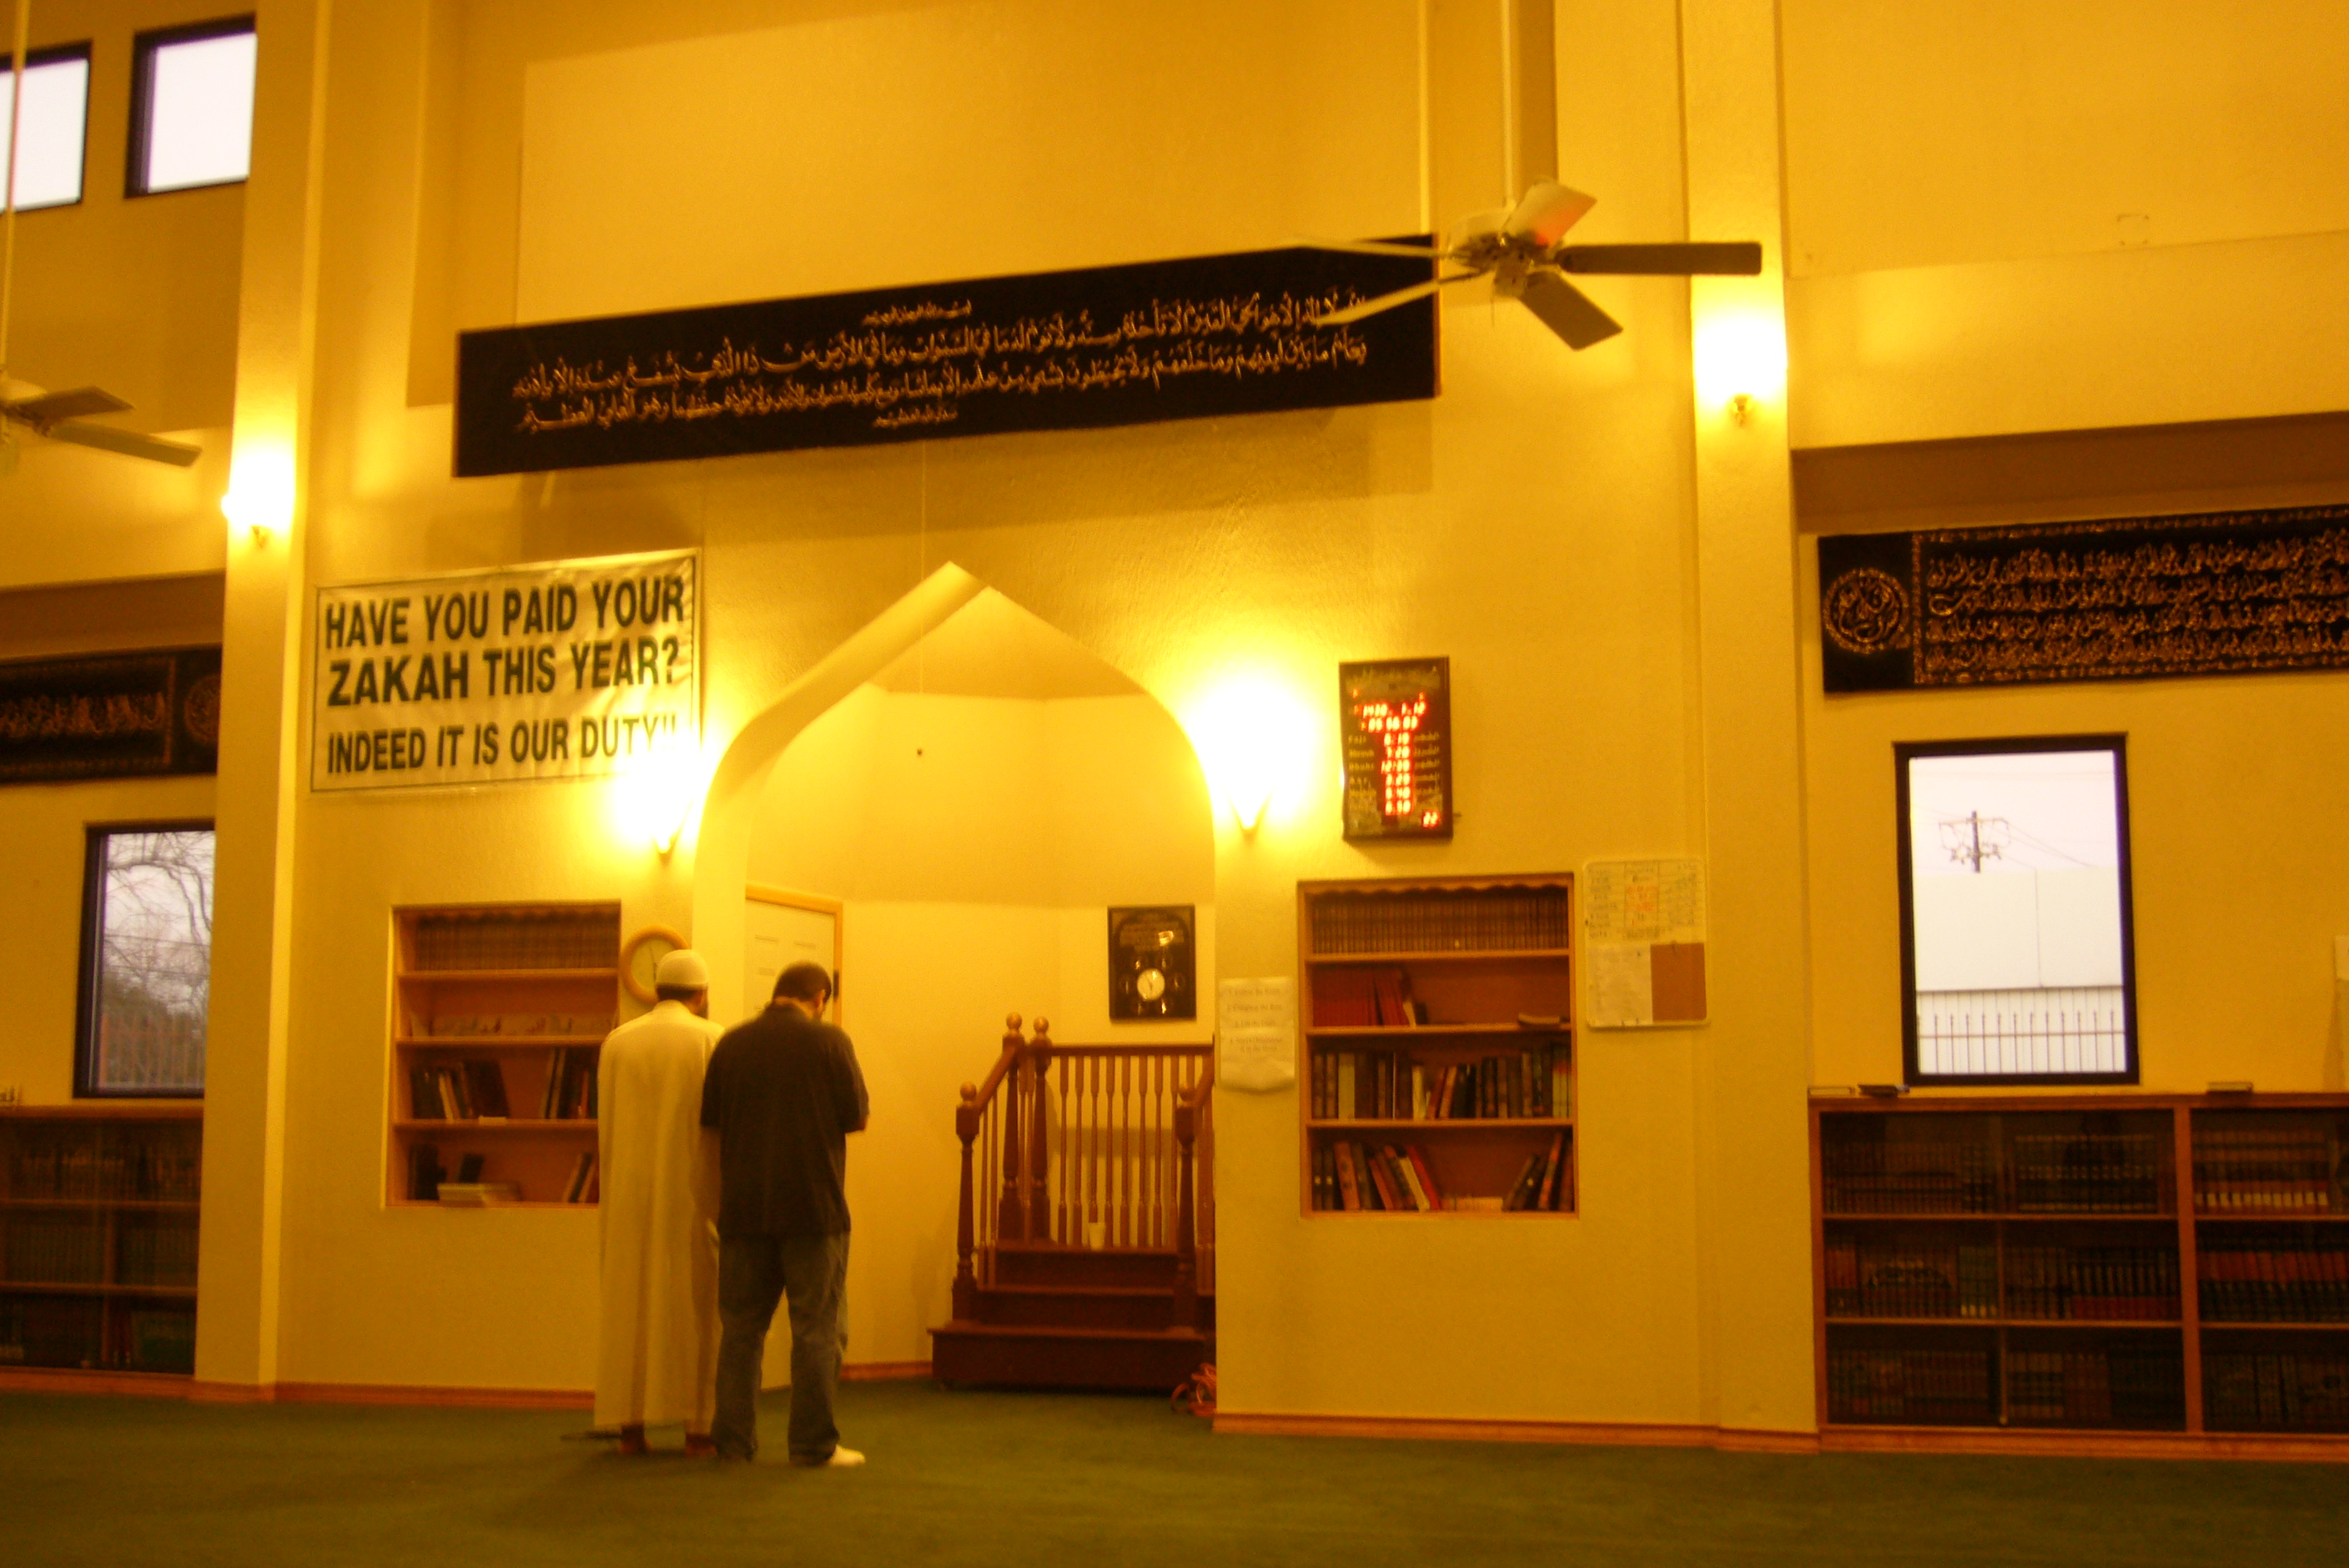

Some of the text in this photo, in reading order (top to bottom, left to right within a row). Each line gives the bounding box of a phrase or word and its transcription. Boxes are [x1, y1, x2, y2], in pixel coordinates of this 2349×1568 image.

[325, 573, 685, 650] HAVE YOU PAID YOUR
[327, 633, 680, 707] ZAKAH THIS YEAR?
[327, 726, 426, 775] INDEED
[437, 723, 465, 768] IT
[473, 720, 500, 766] IS
[510, 717, 570, 764] OUR
